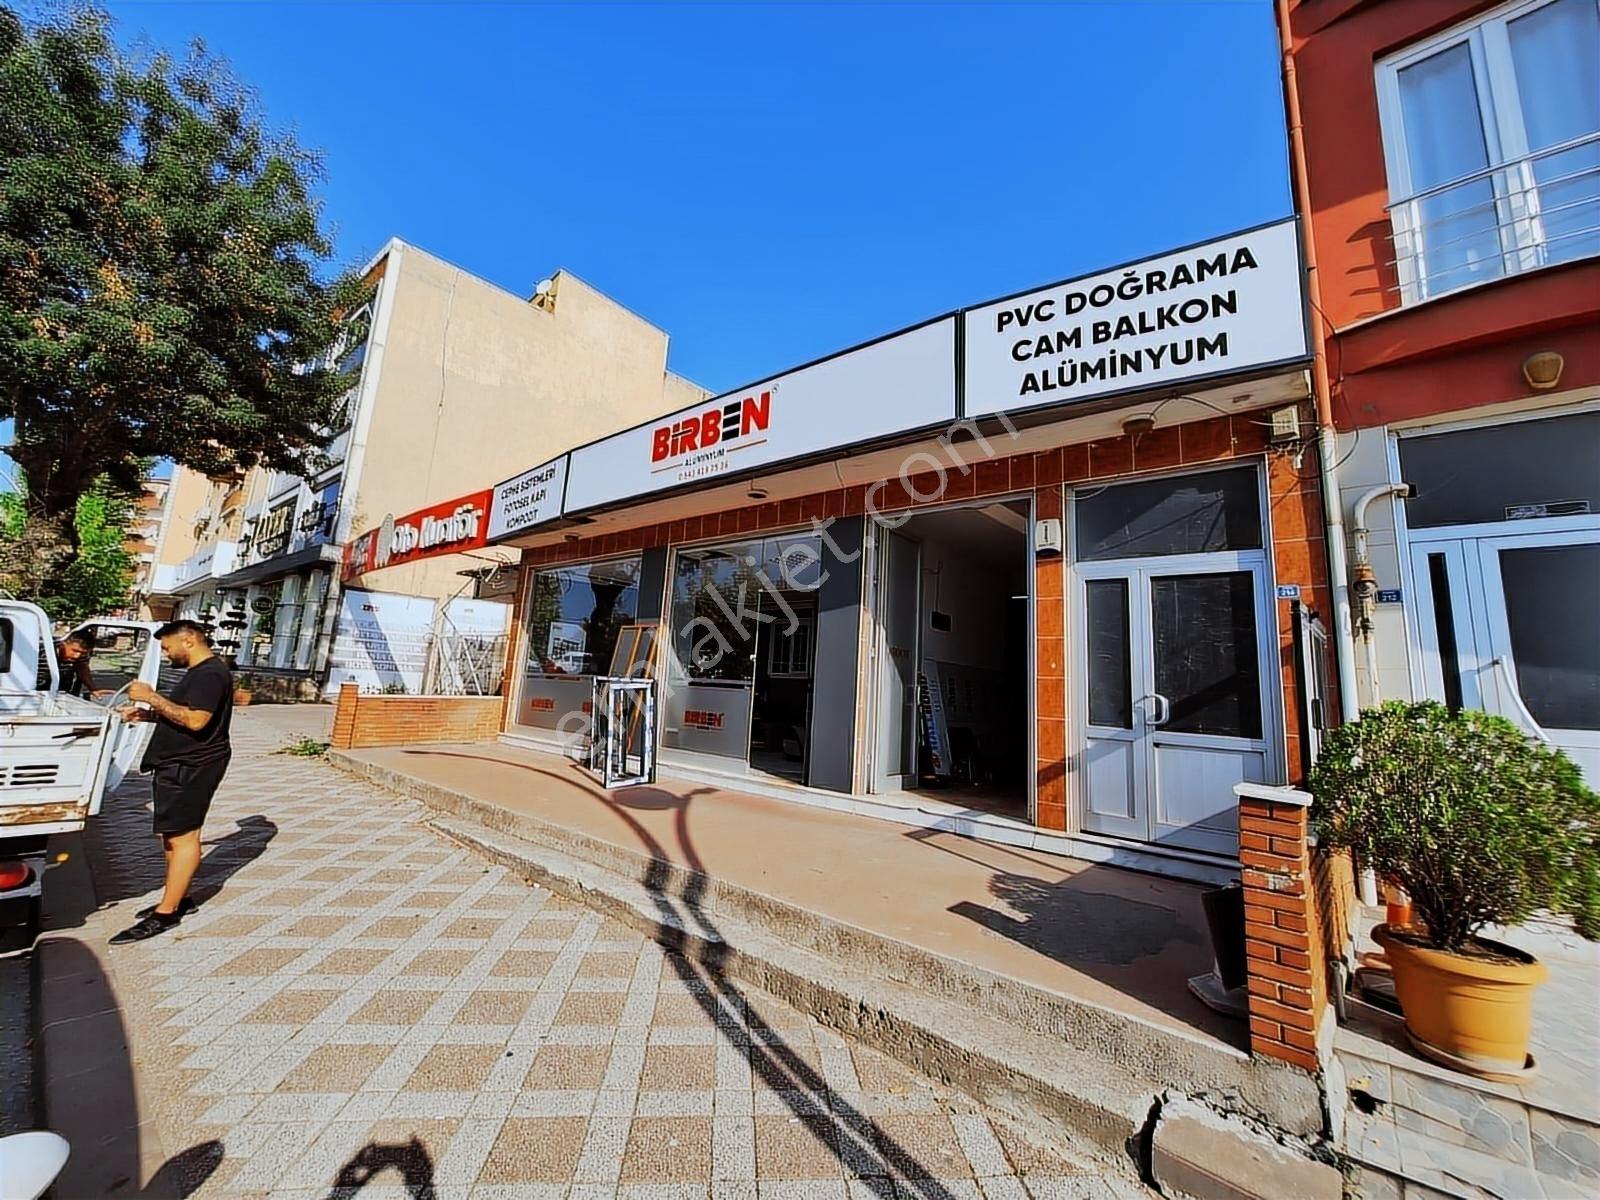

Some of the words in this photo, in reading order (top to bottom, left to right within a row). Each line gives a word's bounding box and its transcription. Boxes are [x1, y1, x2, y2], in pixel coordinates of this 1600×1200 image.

[997, 299, 1055, 332] PVC
[1065, 247, 1258, 315] DOĞRAMA
[1011, 327, 1082, 361] CAM
[1092, 290, 1237, 344] BALKON
[1019, 332, 1228, 395] ALÜMİNYUM
